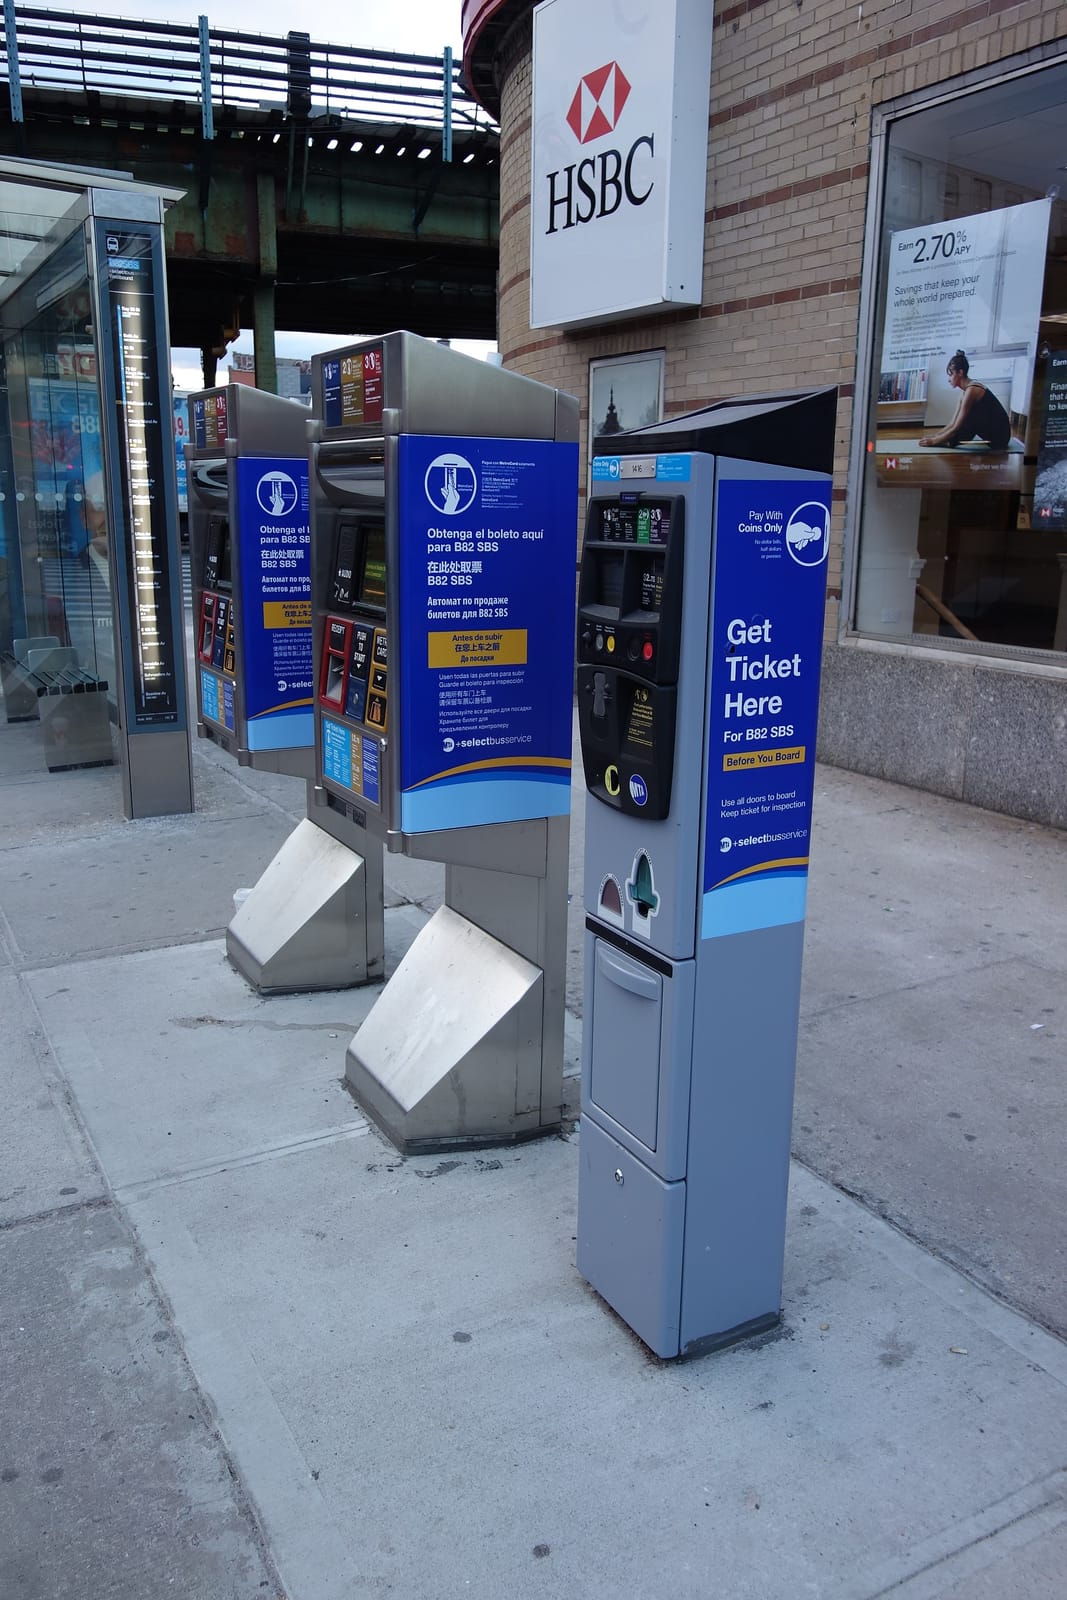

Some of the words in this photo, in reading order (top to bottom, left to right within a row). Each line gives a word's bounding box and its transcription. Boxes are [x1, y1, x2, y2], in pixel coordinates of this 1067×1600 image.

[545, 132, 654, 235] HSBC
[898, 243, 914, 251] Earn
[954, 245, 971, 256] APY
[895, 284, 922, 295] Savings
[924, 282, 938, 291] that
[941, 278, 959, 287] keep
[962, 274, 980, 285] your
[894, 298, 915, 307] whole
[917, 294, 937, 303] world
[940, 288, 976, 301] prepared.
[639, 510, 643, 518] 2
[651, 510, 655, 519] 3
[749, 511, 764, 522] Pay
[766, 510, 783, 520] With
[260, 526, 295, 535] Obtenga
[428, 528, 472, 540] Obtenga
[476, 529, 484, 539] el
[487, 529, 519, 539] boleto
[522, 529, 544, 541] aquí
[739, 523, 762, 533] Coins
[764, 523, 783, 534] Only
[428, 543, 451, 554] para
[455, 542, 474, 552] B82
[477, 542, 498, 552] SBS
[428, 561, 482, 574] 在此处取票
[428, 576, 448, 586] B82
[450, 576, 472, 585] SBS
[428, 597, 461, 606] Автомат
[474, 597, 508, 607] продаже
[428, 610, 460, 619] билетов
[462, 610, 477, 619] для
[479, 609, 493, 617] B82
[495, 608, 508, 617] SBS
[727, 619, 772, 645] Get
[358, 643, 363, 651] TO
[455, 643, 500, 652] 在您上车之前
[354, 652, 366, 663] START
[460, 655, 468, 663] До
[726, 654, 801, 681] Ticket
[479, 671, 498, 679] puertas
[725, 693, 782, 718] Here
[724, 731, 742, 743] For
[746, 728, 767, 740] B82
[770, 725, 794, 737] SBS
[727, 757, 754, 766] Before
[758, 754, 772, 763] You
[776, 751, 800, 761] Board
[630, 782, 644, 798] MTA
[746, 796, 766, 804] doors
[776, 791, 795, 799] board
[721, 810, 739, 818] Keep
[741, 807, 759, 816] ticket
[772, 801, 805, 812] inspection
